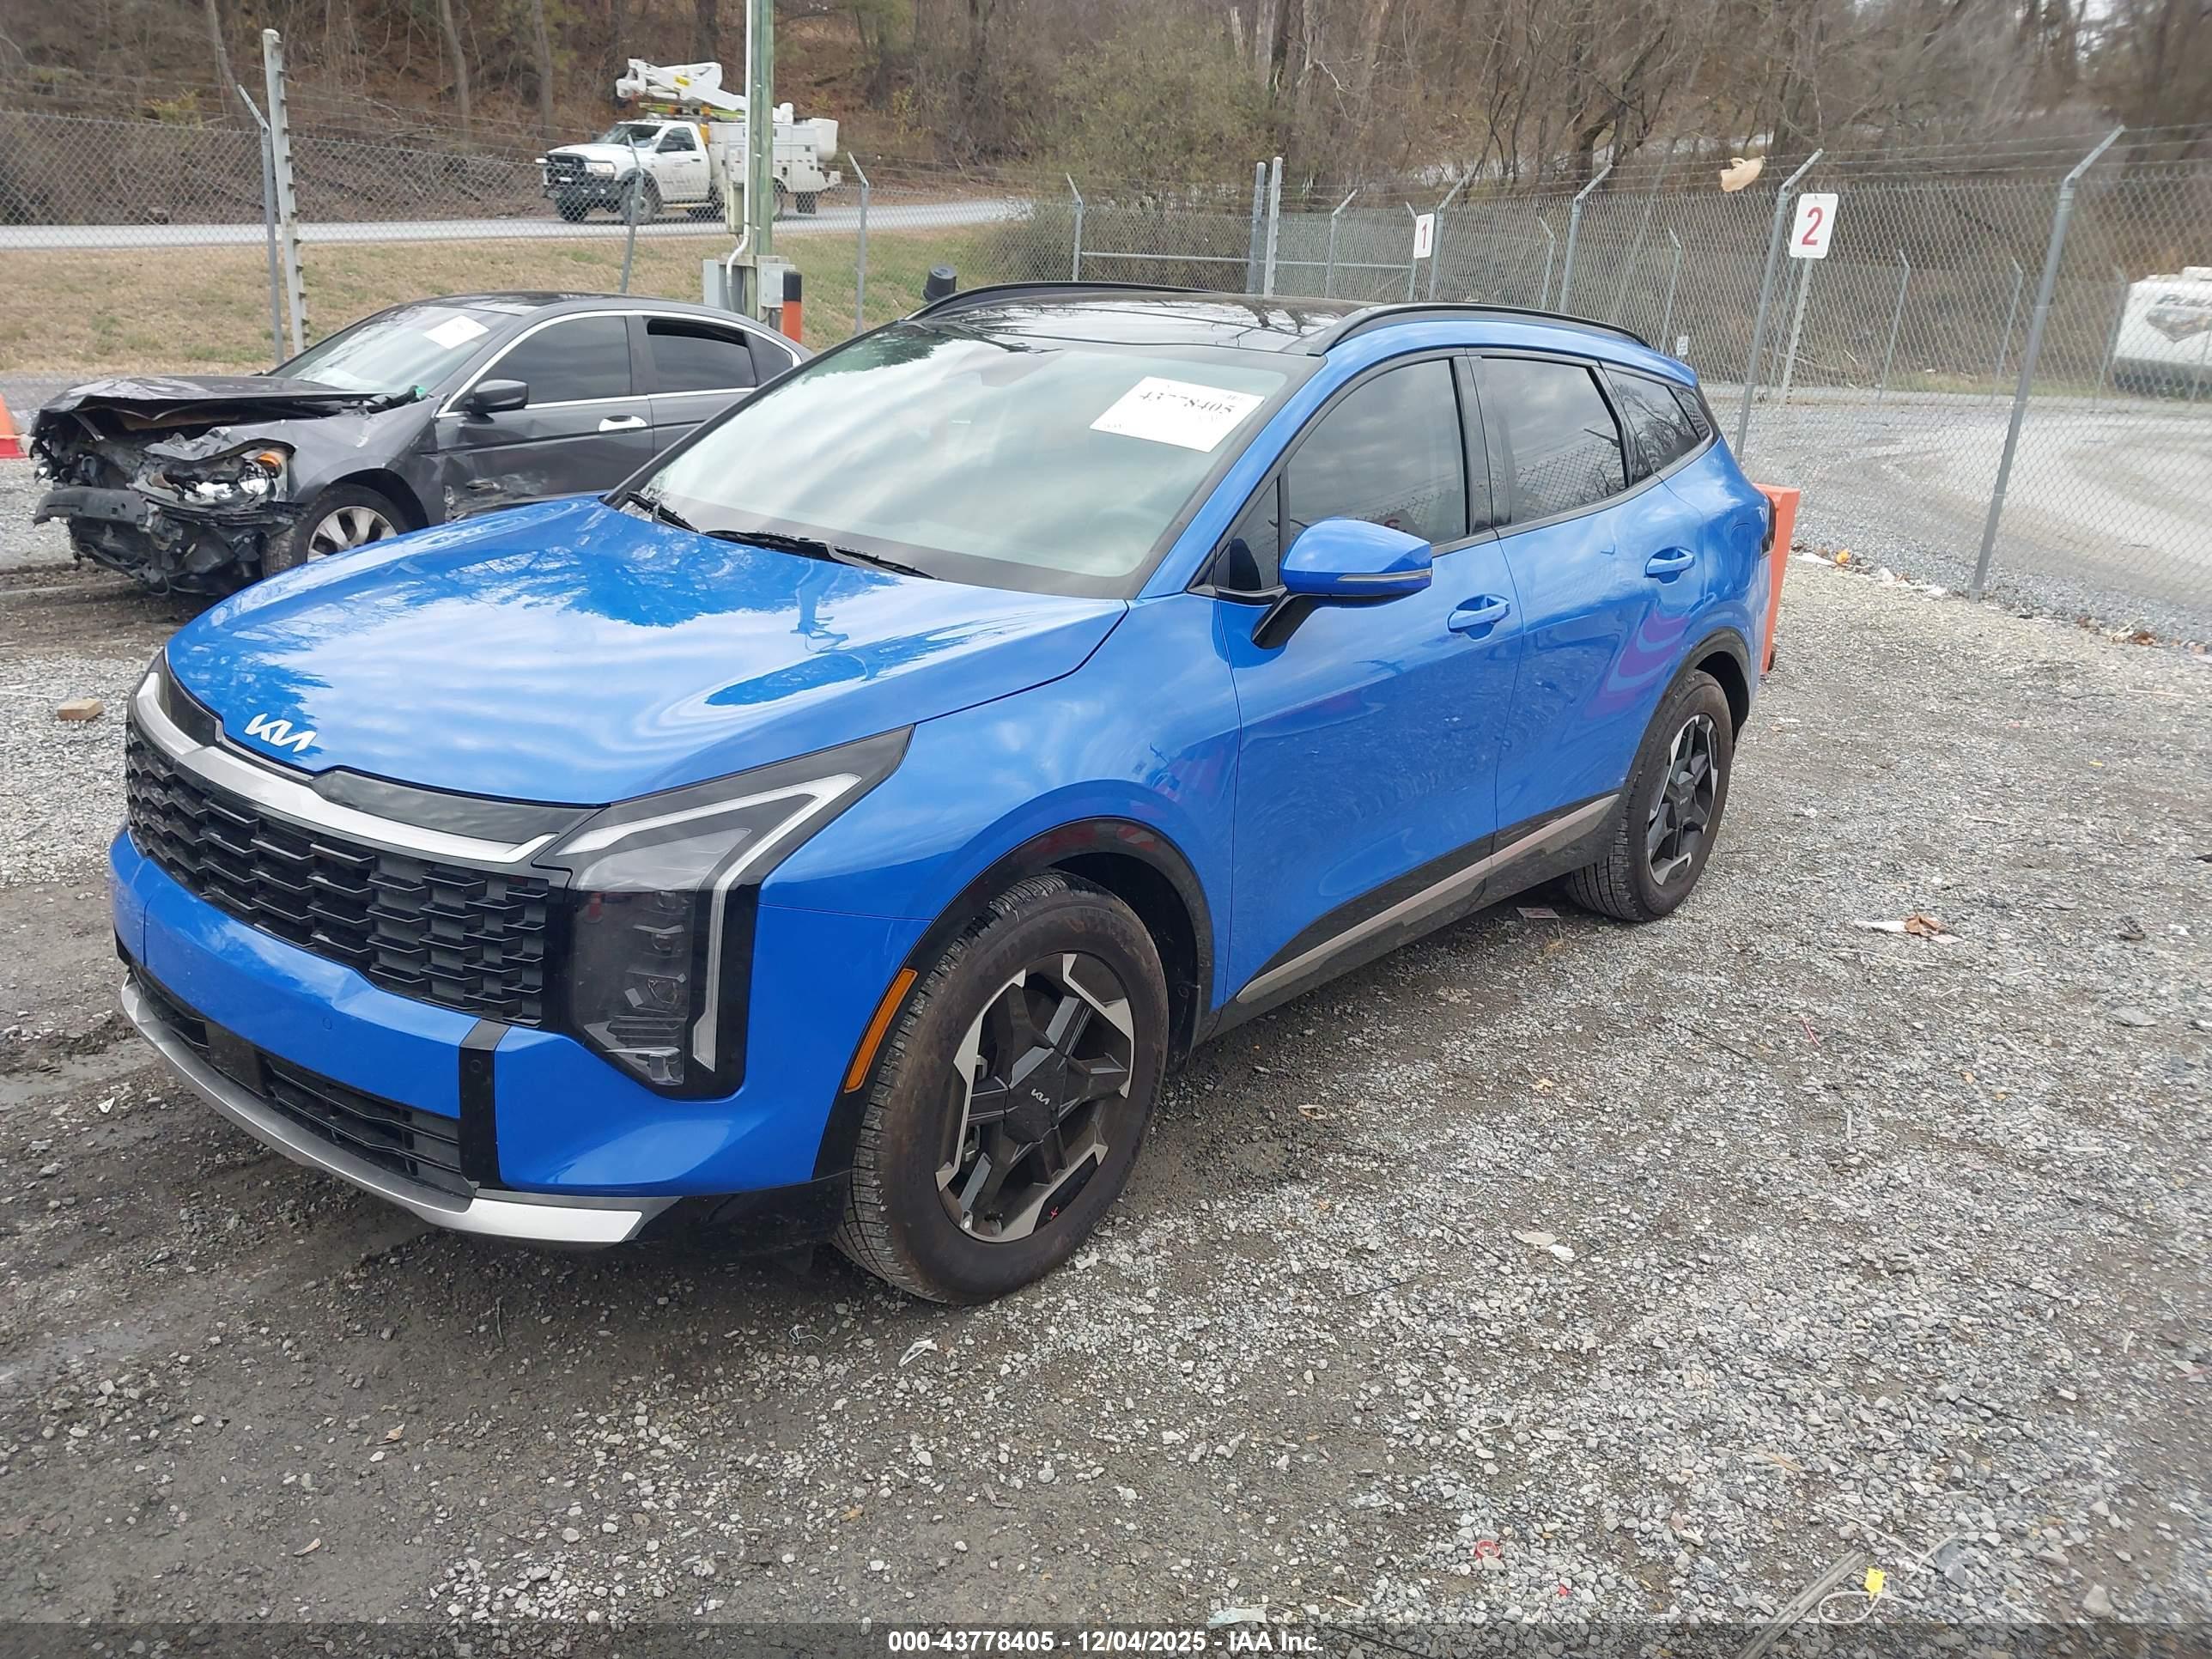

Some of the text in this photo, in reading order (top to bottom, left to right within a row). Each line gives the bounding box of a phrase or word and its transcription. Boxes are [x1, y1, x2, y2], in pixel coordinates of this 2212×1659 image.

[1421, 222, 1428, 250] 1
[1802, 206, 1824, 246] 2
[1139, 391, 1237, 415] 48405
[244, 713, 317, 753] KIA
[1030, 1088, 1051, 1105] KIA
